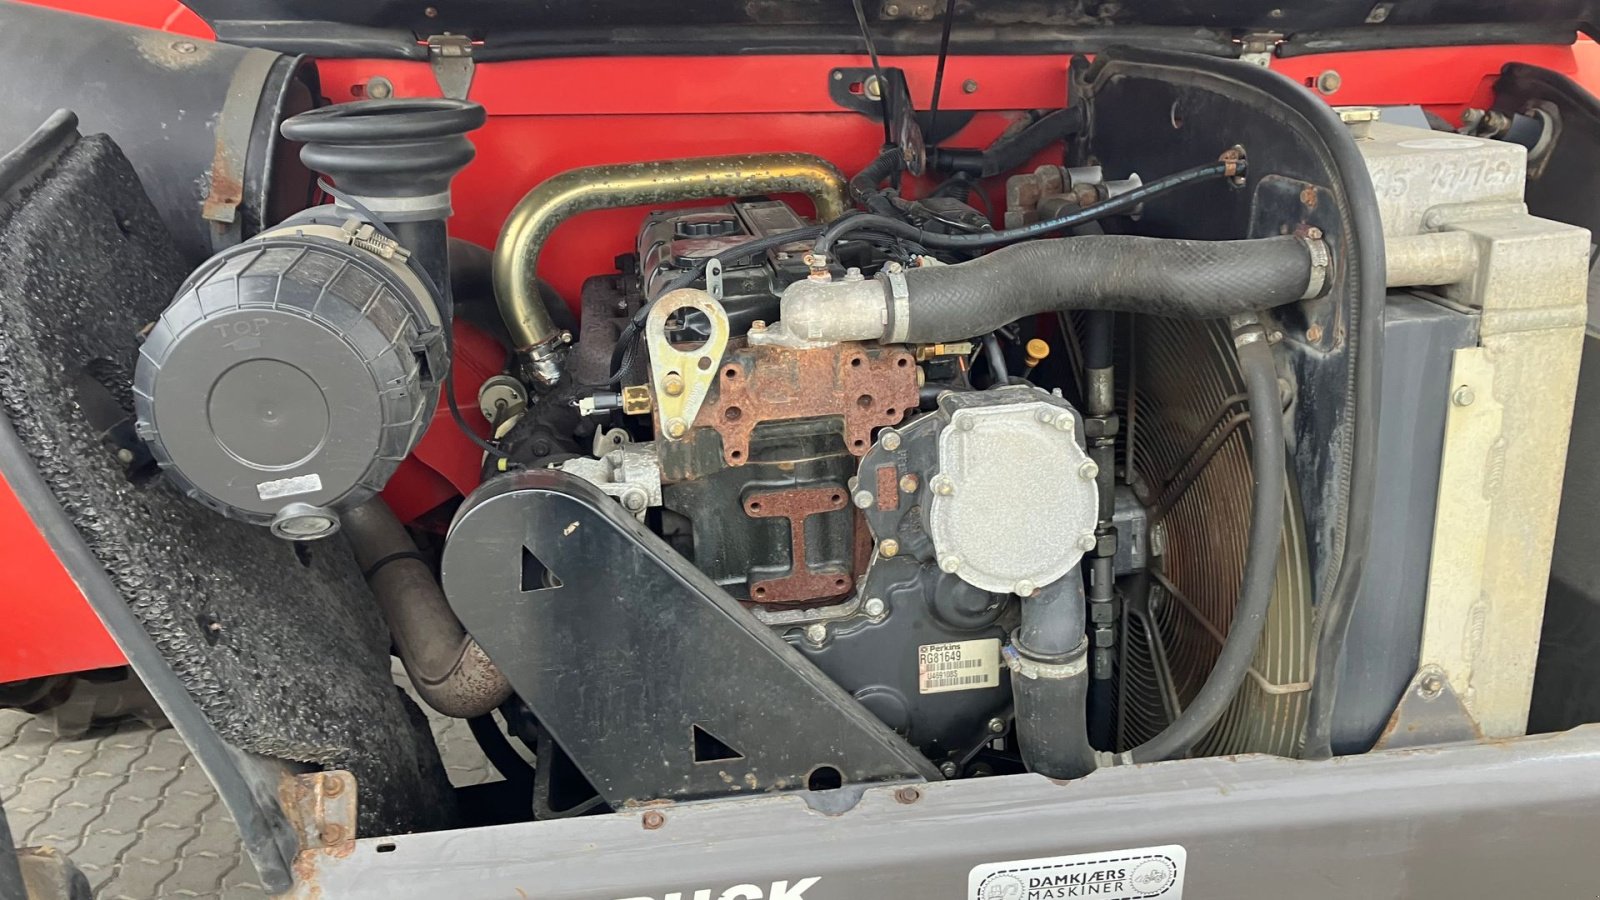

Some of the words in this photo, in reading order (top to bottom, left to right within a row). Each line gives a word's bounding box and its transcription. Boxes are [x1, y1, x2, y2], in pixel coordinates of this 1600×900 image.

[213, 317, 269, 337] TOP
[930, 644, 960, 652] Perkins
[920, 651, 961, 664] RG81649
[1029, 869, 1126, 888] DAMKJÆRS
[1028, 882, 1124, 900] MASKINER
